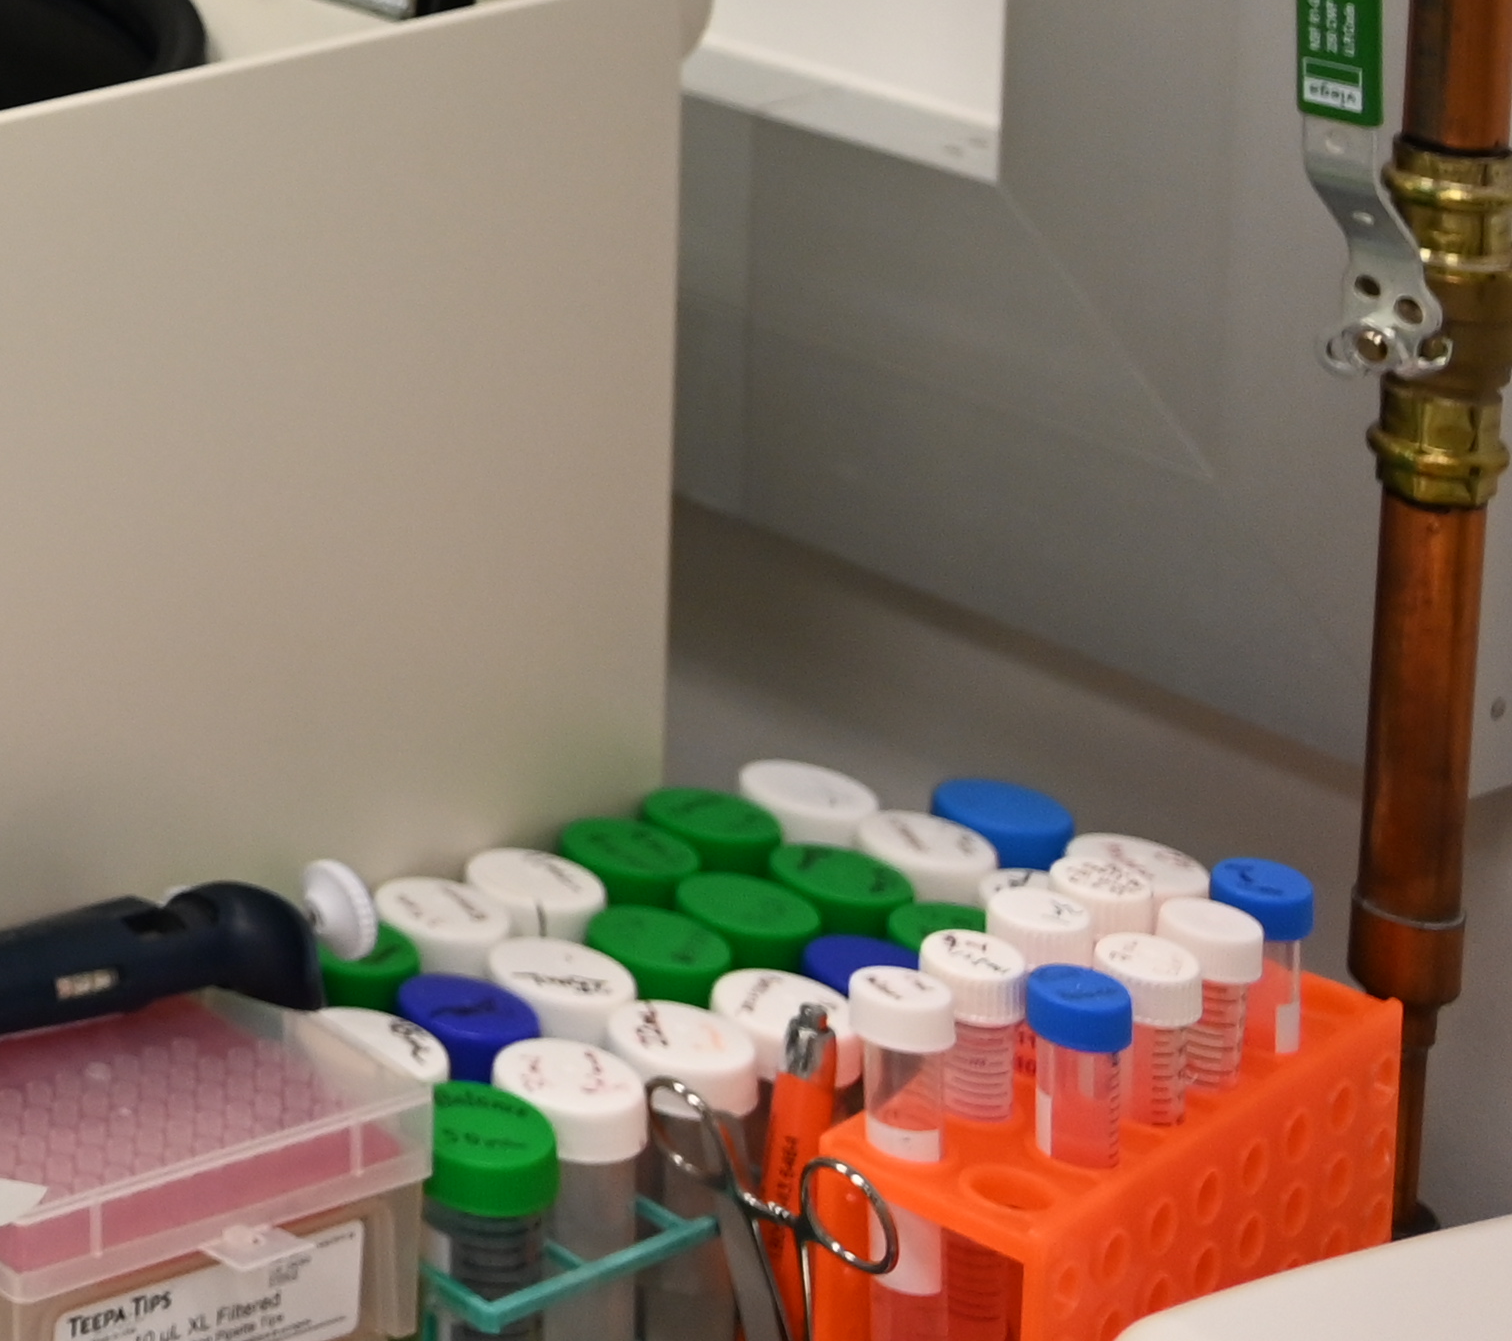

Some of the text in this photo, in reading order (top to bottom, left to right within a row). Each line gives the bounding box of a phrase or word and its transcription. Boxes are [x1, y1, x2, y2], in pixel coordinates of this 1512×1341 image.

[1309, 82, 1357, 108] viega
[68, 1290, 173, 1339] TEEPA TIPS
[187, 1314, 212, 1336] XL
[215, 1289, 282, 1327] Filtered
